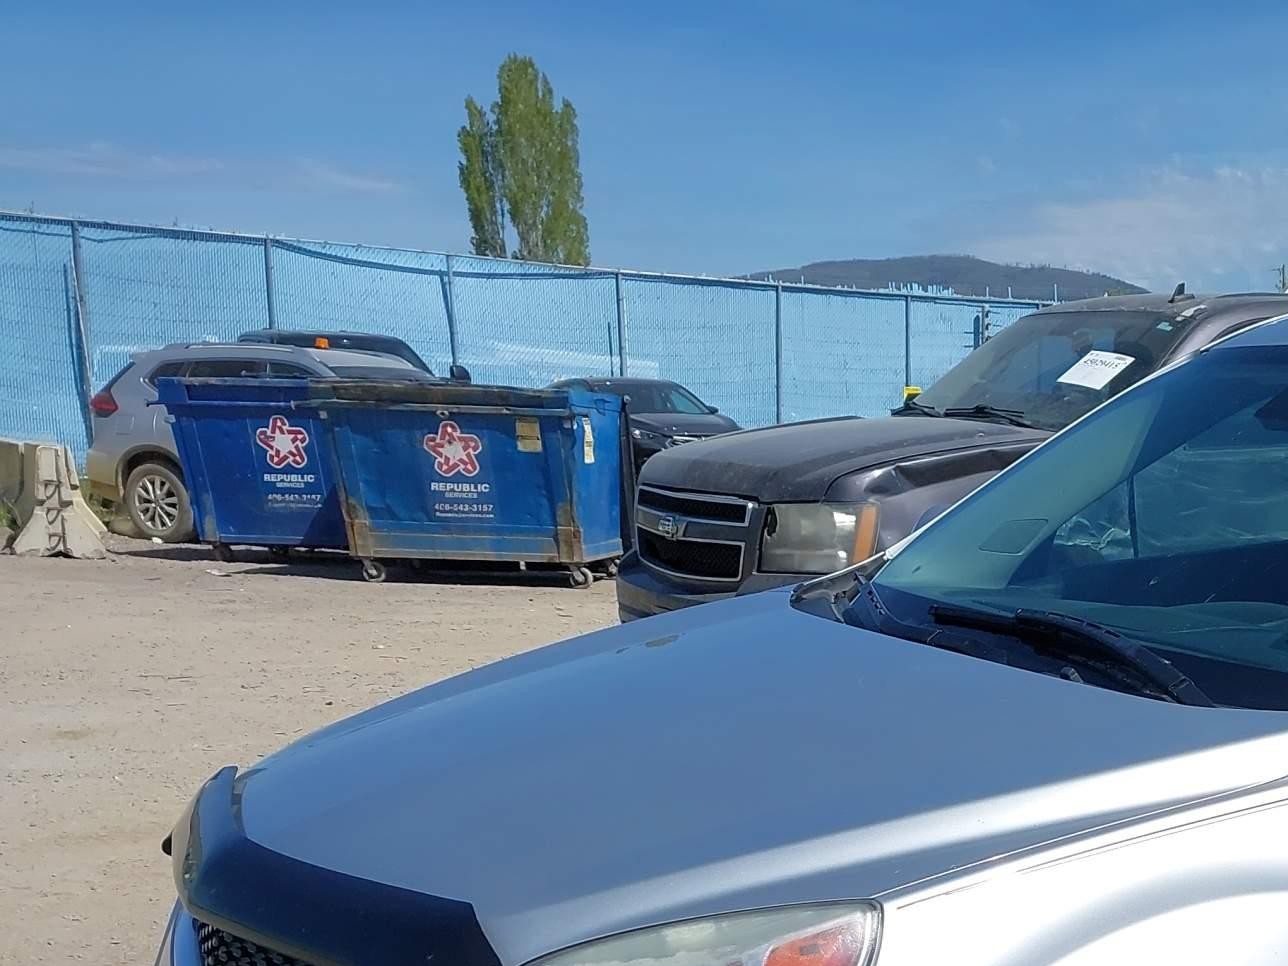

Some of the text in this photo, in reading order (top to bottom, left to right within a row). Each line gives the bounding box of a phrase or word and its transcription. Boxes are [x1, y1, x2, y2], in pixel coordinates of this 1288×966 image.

[263, 473, 315, 482] REPUBLIC
[430, 482, 490, 492] REPUBLIC
[434, 503, 494, 512] 406-543-3157
